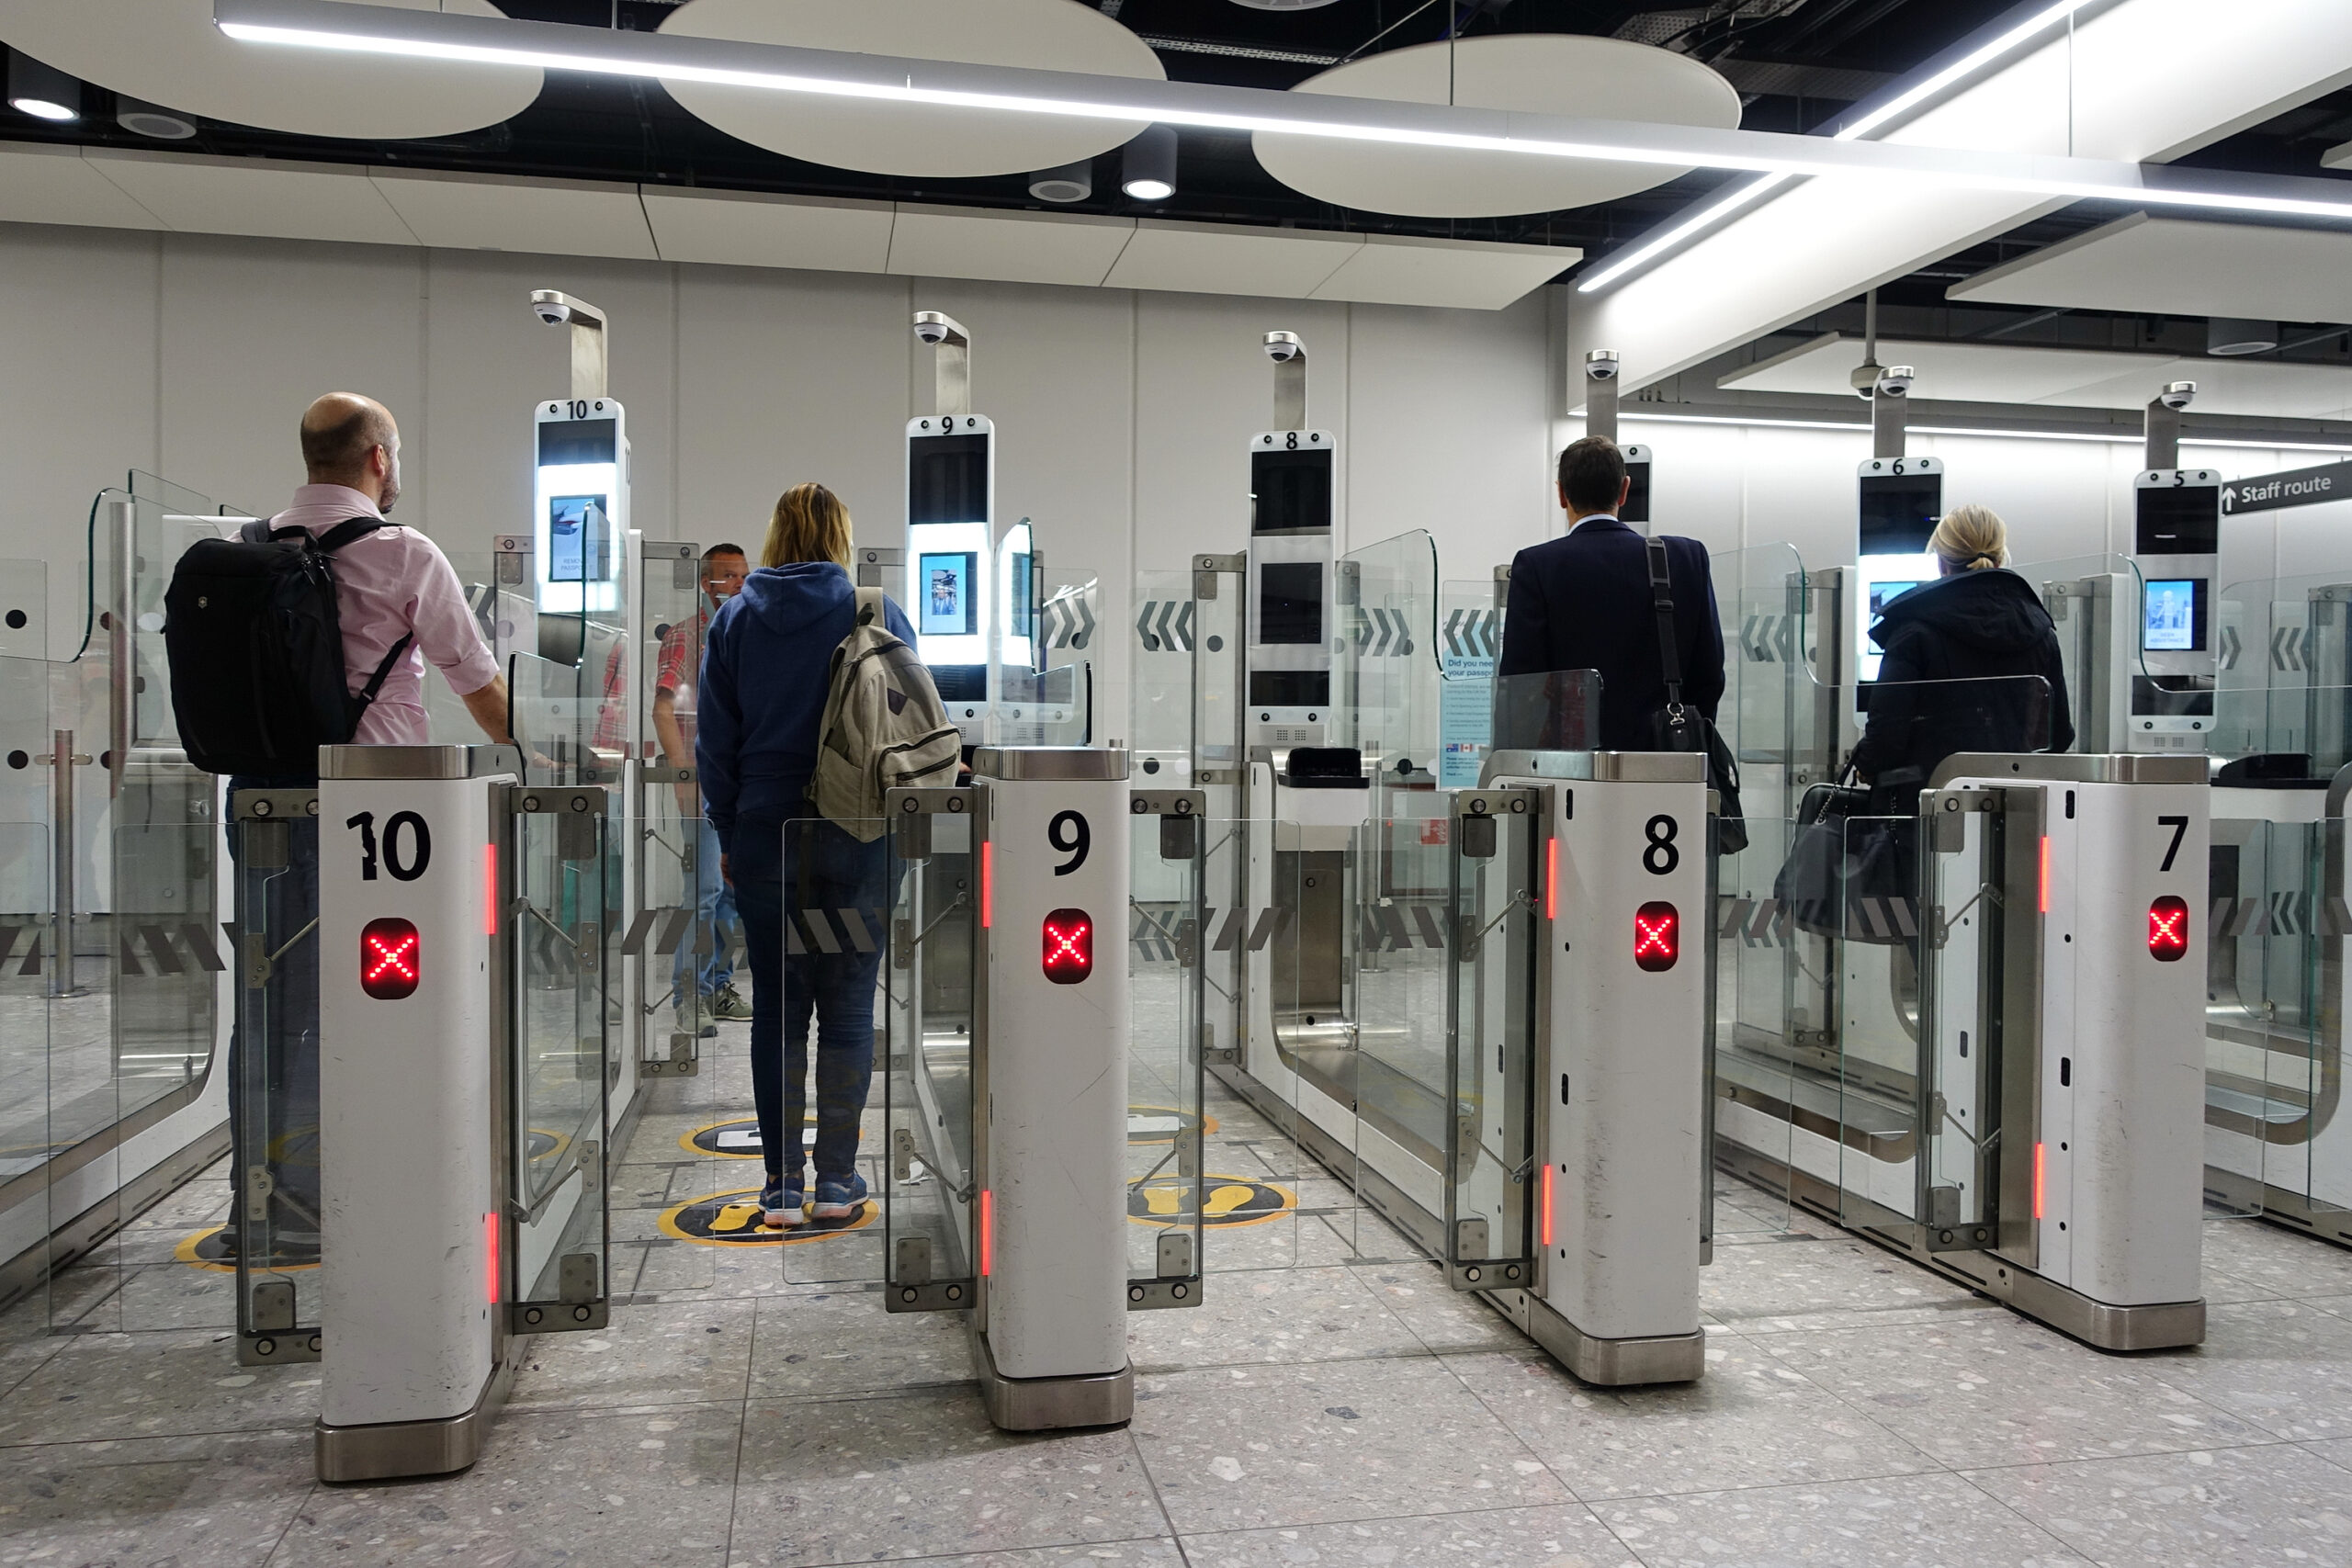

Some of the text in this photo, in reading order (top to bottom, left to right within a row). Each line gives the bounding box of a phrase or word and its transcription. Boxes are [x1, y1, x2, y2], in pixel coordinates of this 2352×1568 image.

[566, 400, 587, 420] 10
[941, 416, 954, 434] 9
[1286, 432, 1297, 450] 8
[1893, 457, 1905, 476] 6
[2173, 470, 2185, 487] 5
[2242, 476, 2332, 503] Staff route
[1463, 660, 1477, 669] you
[345, 810, 431, 882] 10
[1047, 809, 1091, 876] 9
[1643, 814, 1679, 875] 8
[2158, 816, 2188, 872] 7
